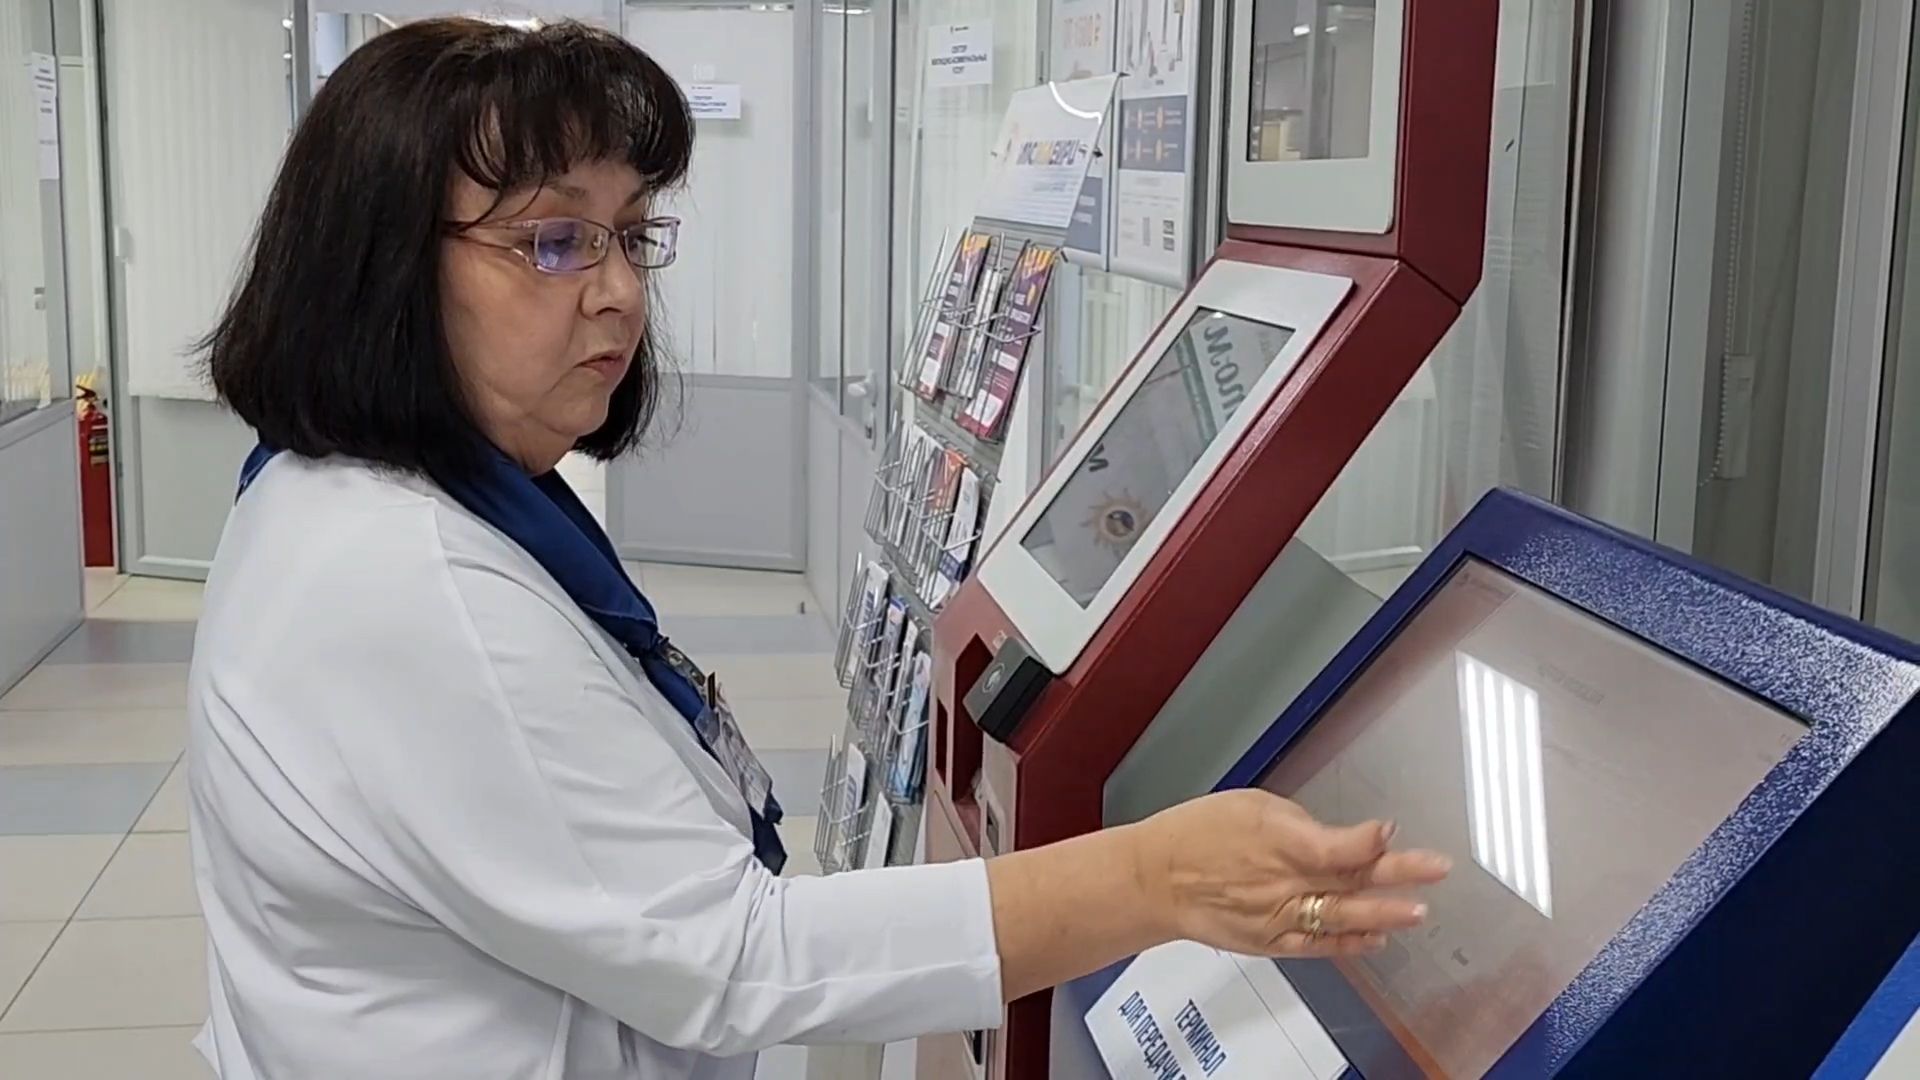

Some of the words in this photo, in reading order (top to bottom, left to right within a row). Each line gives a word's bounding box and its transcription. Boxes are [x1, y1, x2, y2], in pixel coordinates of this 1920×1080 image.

[1118, 990, 1148, 1028] ДЛЯ
[1174, 998, 1227, 1078] ТЕРМИНАЛ
[1132, 1013, 1182, 1080] ПЕРЕДАЧИ
